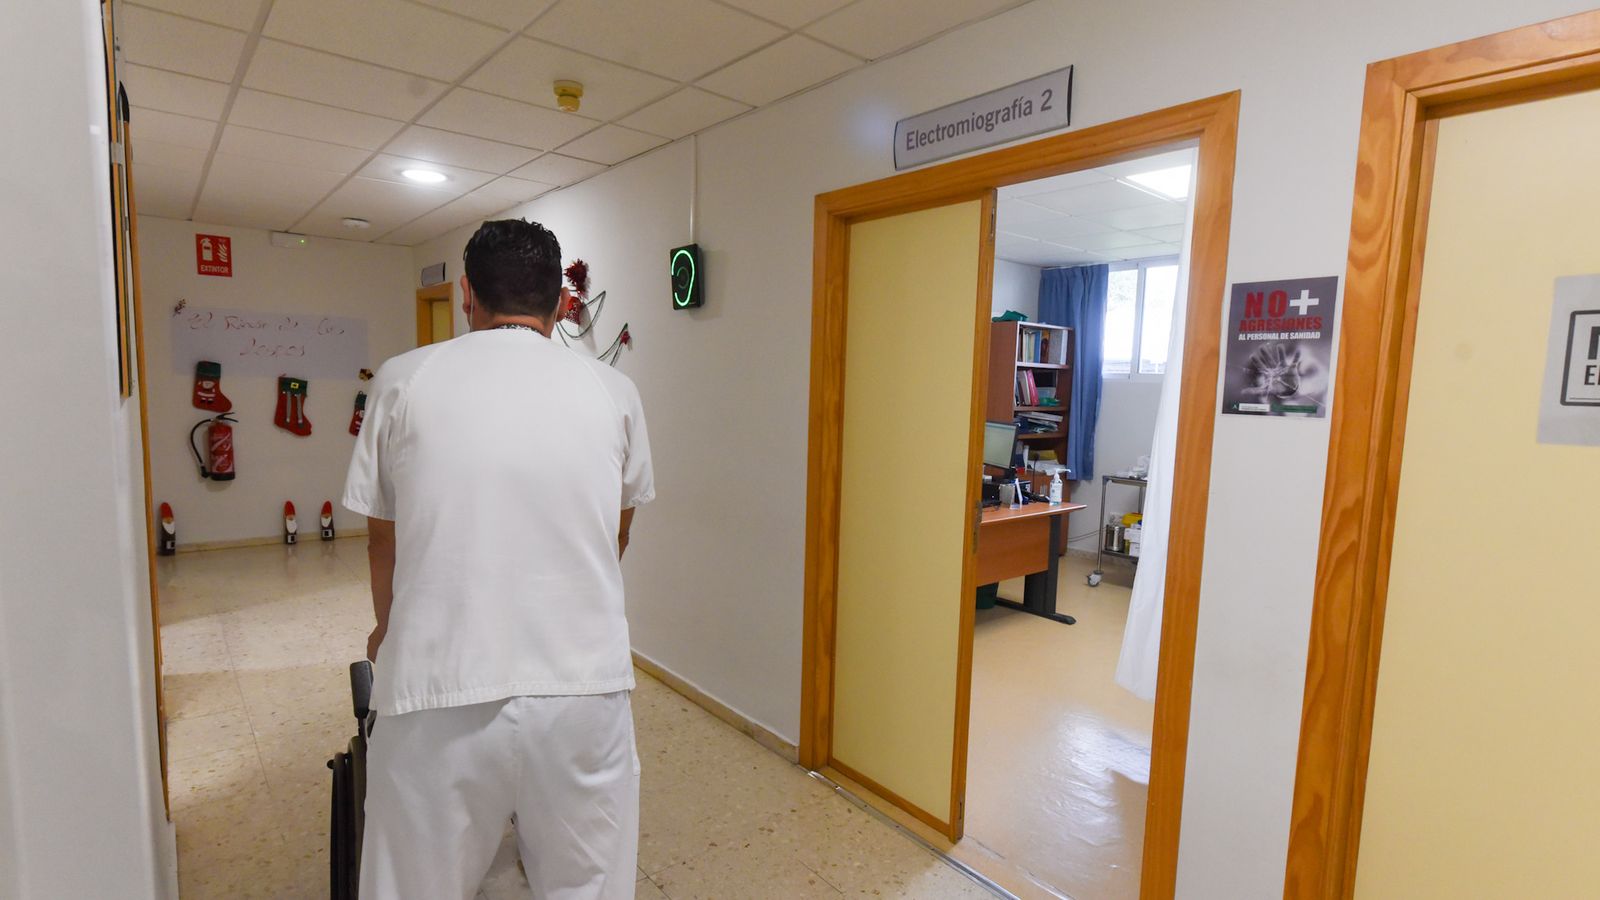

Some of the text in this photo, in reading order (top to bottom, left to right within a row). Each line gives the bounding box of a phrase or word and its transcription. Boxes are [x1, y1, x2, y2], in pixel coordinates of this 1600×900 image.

[906, 88, 1053, 151] Electromiografía 2
[200, 264, 229, 274] EXTINTOR
[1239, 316, 1323, 332] AGRESIONES
[1238, 331, 1321, 341] AL PERSONAL DE SANIDAD
